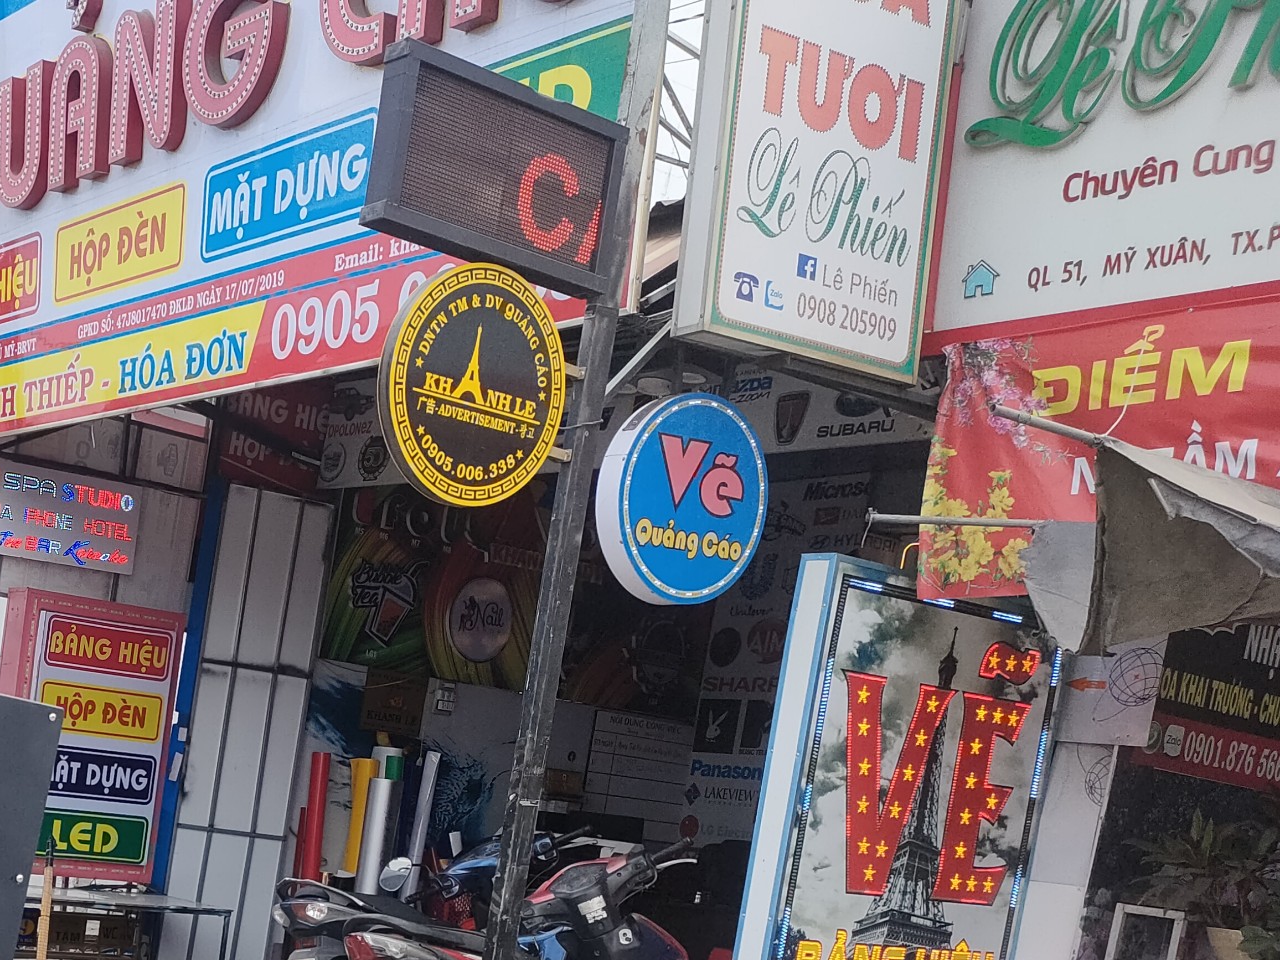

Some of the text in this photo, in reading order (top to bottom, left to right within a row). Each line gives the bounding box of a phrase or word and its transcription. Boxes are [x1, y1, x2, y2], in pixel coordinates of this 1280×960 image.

[758, 24, 925, 165] TƯƠI
[208, 143, 367, 240] MẶT DỰNG
[1062, 139, 1276, 202] Chuyên Cung
[69, 210, 168, 287] HỘP ĐÈN
[334, 243, 385, 273] Email:
[1027, 265, 1051, 293] QL
[1060, 259, 1088, 286] 51,
[1102, 247, 1137, 278] MỸ
[1144, 236, 1211, 271] XUÂN,
[77, 322, 99, 340] GPKD
[196, 284, 221, 309] NGÀY
[225, 270, 285, 300] 17/07/2019
[822, 264, 898, 308] Lê Phiến
[272, 278, 380, 361] 0905
[419, 314, 449, 356] DNTN
[448, 296, 469, 318] TM
[471, 294, 481, 308] &
[485, 294, 504, 311] DV
[534, 353, 548, 388] CÁO
[797, 291, 897, 343] 0908 205909
[23, 353, 94, 413] THIẾP
[118, 343, 176, 394] HÓA
[184, 329, 248, 381] ĐƠN
[1024, 324, 1252, 417] ĐIỂM
[816, 419, 892, 437] SUBARU
[421, 434, 516, 481] 0905.006.338
[658, 432, 744, 518] Vẽ
[3, 472, 57, 499] SPA
[61, 483, 134, 512] STUDIO
[0, 530, 22, 549] Tea
[25, 535, 62, 555] BAR
[63, 540, 129, 566] Karaoke
[84, 518, 132, 541] HOTEL
[635, 518, 743, 562] Quảng Cáo
[49, 624, 168, 673] BẢNG HIỆU
[102, 698, 148, 730] ĐÈN
[1178, 672, 1209, 708] KHAI
[85, 765, 149, 795] DỰNG
[841, 641, 1041, 906] VẼ
[51, 819, 119, 854] LED
